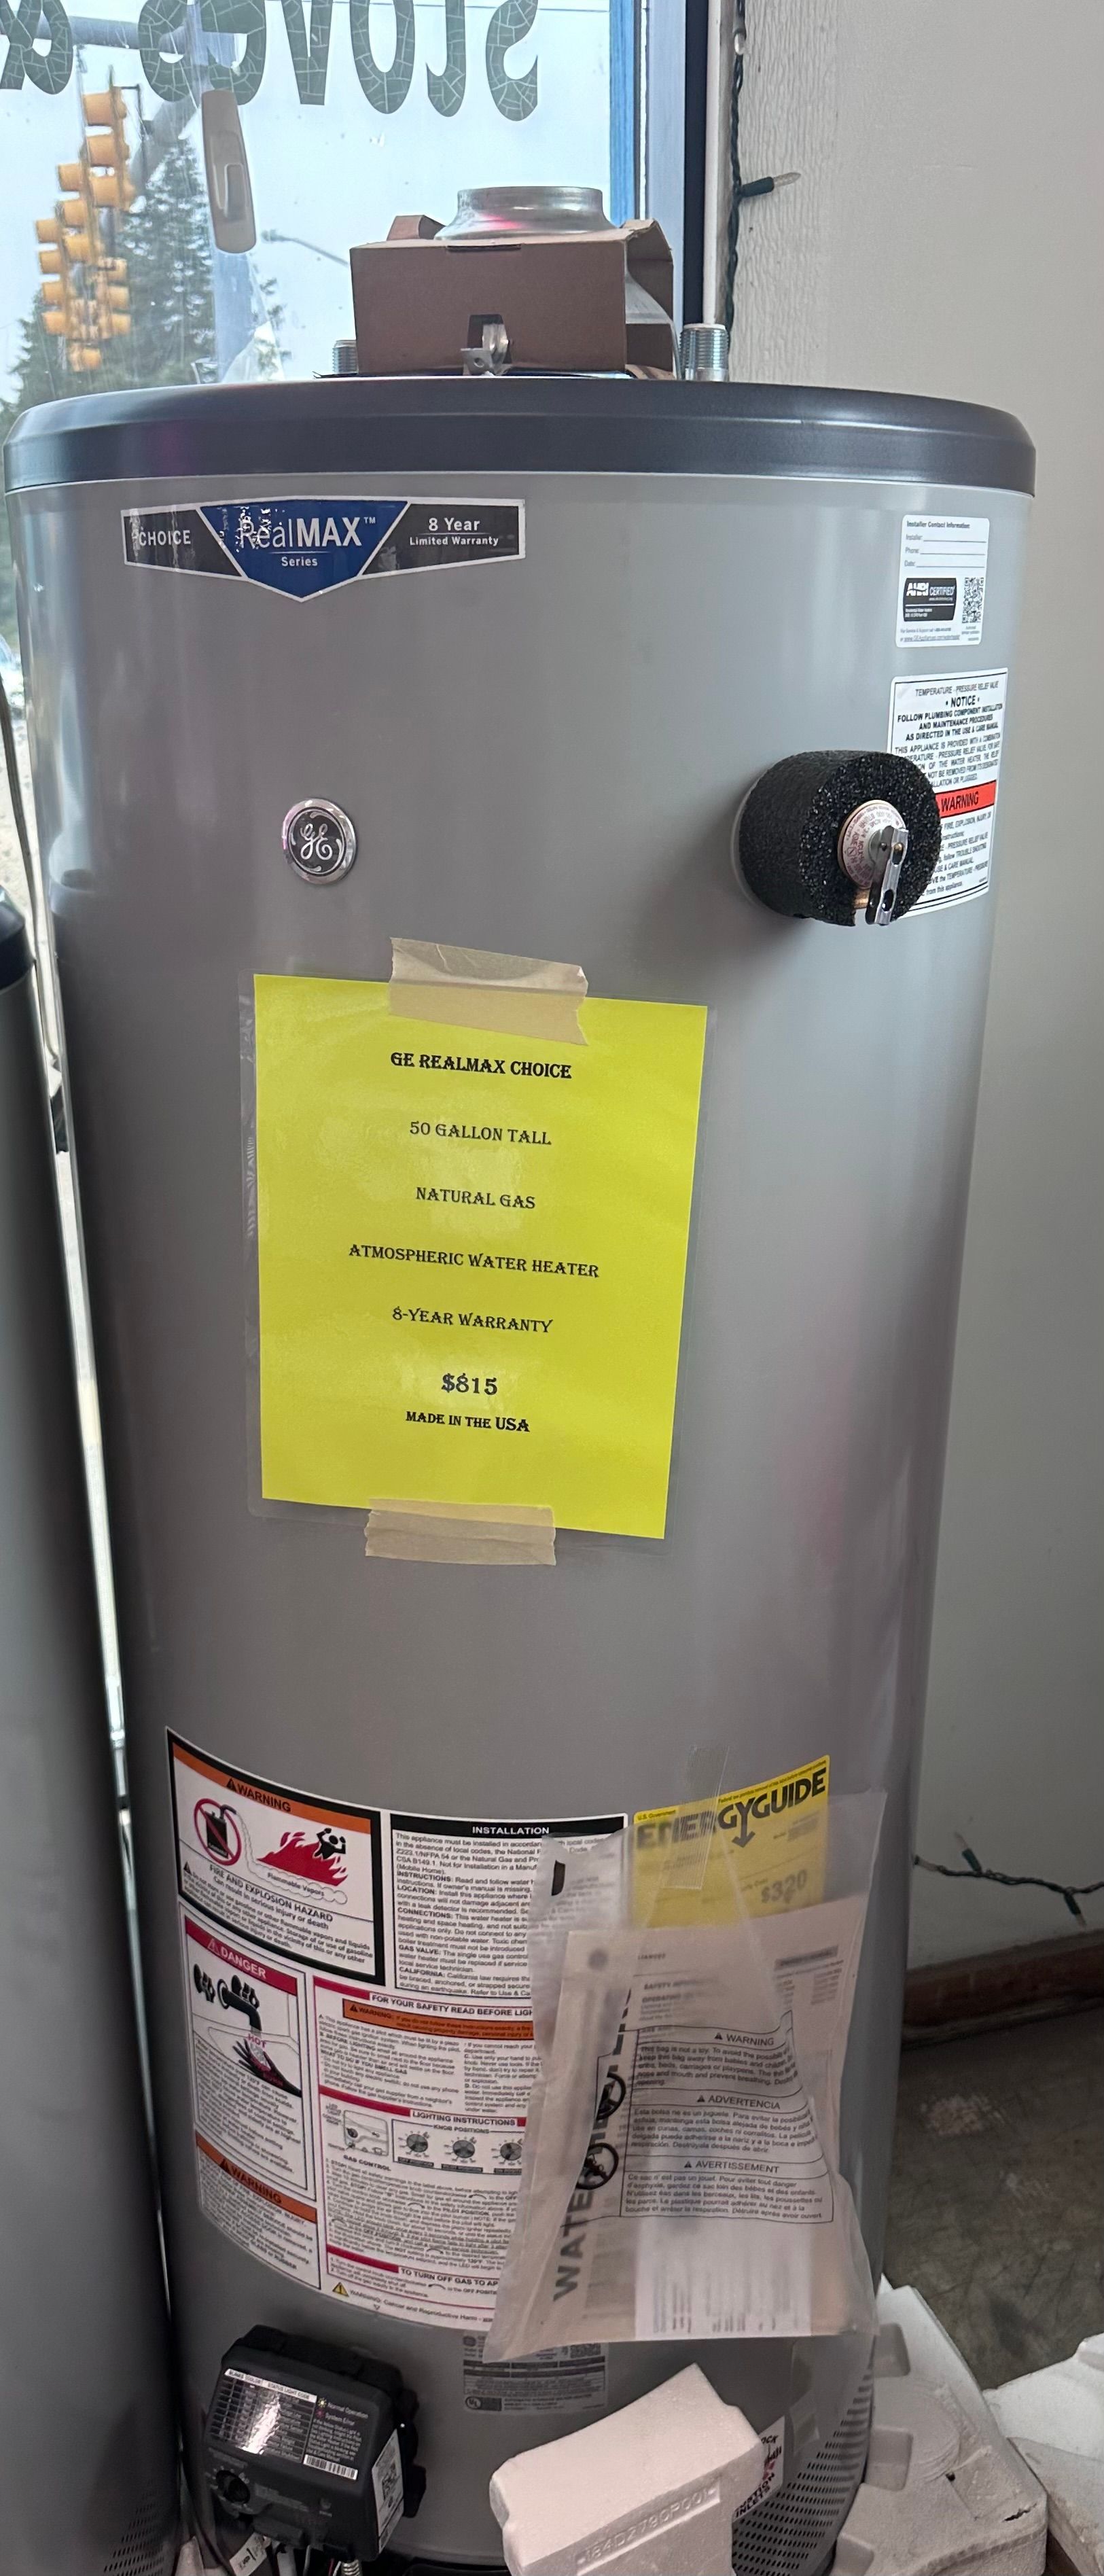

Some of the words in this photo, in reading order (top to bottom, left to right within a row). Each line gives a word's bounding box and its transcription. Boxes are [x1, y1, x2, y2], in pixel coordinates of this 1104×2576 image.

[429, 518, 439, 531] 8
[443, 518, 480, 532] Year
[139, 529, 192, 546] CHOICE
[410, 535, 448, 547] Limited
[452, 535, 499, 548] Warranty
[281, 556, 318, 568] Series
[915, 686, 952, 696] TEMPERATURE
[950, 695, 976, 707] NOTICE
[897, 713, 923, 722] FOLLOW
[925, 711, 952, 720] PLUMBING
[955, 707, 981, 717] COMPONENT
[919, 722, 931, 730] AND
[933, 718, 968, 728] MAINTENANCE
[969, 714, 993, 723] PROCEDURES
[916, 730, 944, 740] DIRECTED
[910, 743, 939, 752] APPLIANCE
[947, 739, 968, 747] PROVIDED
[938, 749, 961, 759] PRESSURE
[940, 792, 979, 812] WARNING
[391, 1053, 414, 1068] GE
[419, 1054, 505, 1074] REALMAX
[510, 1061, 572, 1079] CHOICE
[410, 1121, 430, 1135] 50
[435, 1123, 503, 1142] GALLON
[508, 1129, 552, 1145] TALL
[416, 1186, 496, 1206] NATURAL
[499, 1194, 535, 1209] GAS
[349, 1243, 463, 1266] ATMOSPHERIC
[468, 1253, 527, 1272] WATER
[532, 1259, 599, 1278] HEATER
[393, 1306, 454, 1325] 8-YEAR
[458, 1313, 553, 1333] WARRANTY
[442, 1373, 498, 1396] $815
[406, 1411, 446, 1425] MADE
[448, 1415, 461, 1426] IN
[465, 1416, 491, 1428] THE
[495, 1417, 530, 1432] USA
[238, 1784, 291, 1812] WARNING
[472, 1826, 550, 1835] INSTALLATION
[412, 1835, 443, 1844] appliance
[268, 1872, 301, 1890] Flammable
[302, 1885, 324, 1897] Vapors
[760, 1869, 808, 1903] $320
[209, 1864, 224, 1877] FIRE
[226, 1874, 243, 1888] AND
[245, 1884, 291, 1909] EXPLOSION
[294, 1903, 333, 1922] HAZARD
[433, 1903, 459, 1911] detector
[275, 1907, 296, 1920] injury
[307, 1917, 329, 1930] death
[398, 1915, 421, 1924] heating
[219, 1947, 267, 1979] DANGER
[372, 1994, 389, 2004] FOR
[391, 1998, 414, 2008] YOUR
[416, 2002, 449, 2013] SAFETY
[451, 2007, 474, 2015] READ
[247, 2034, 266, 2047] HOT
[726, 2034, 774, 2046] WARNING
[707, 2095, 781, 2110] ADVERTENCIA
[412, 2112, 451, 2123] LIGHTING
[453, 2115, 516, 2125] INSTRUCTIONS
[455, 2125, 490, 2134] POSITIONS
[695, 2160, 780, 2174] AVERTISSEMENT
[231, 2166, 283, 2204] WARNING
[414, 2270, 435, 2281] TURN
